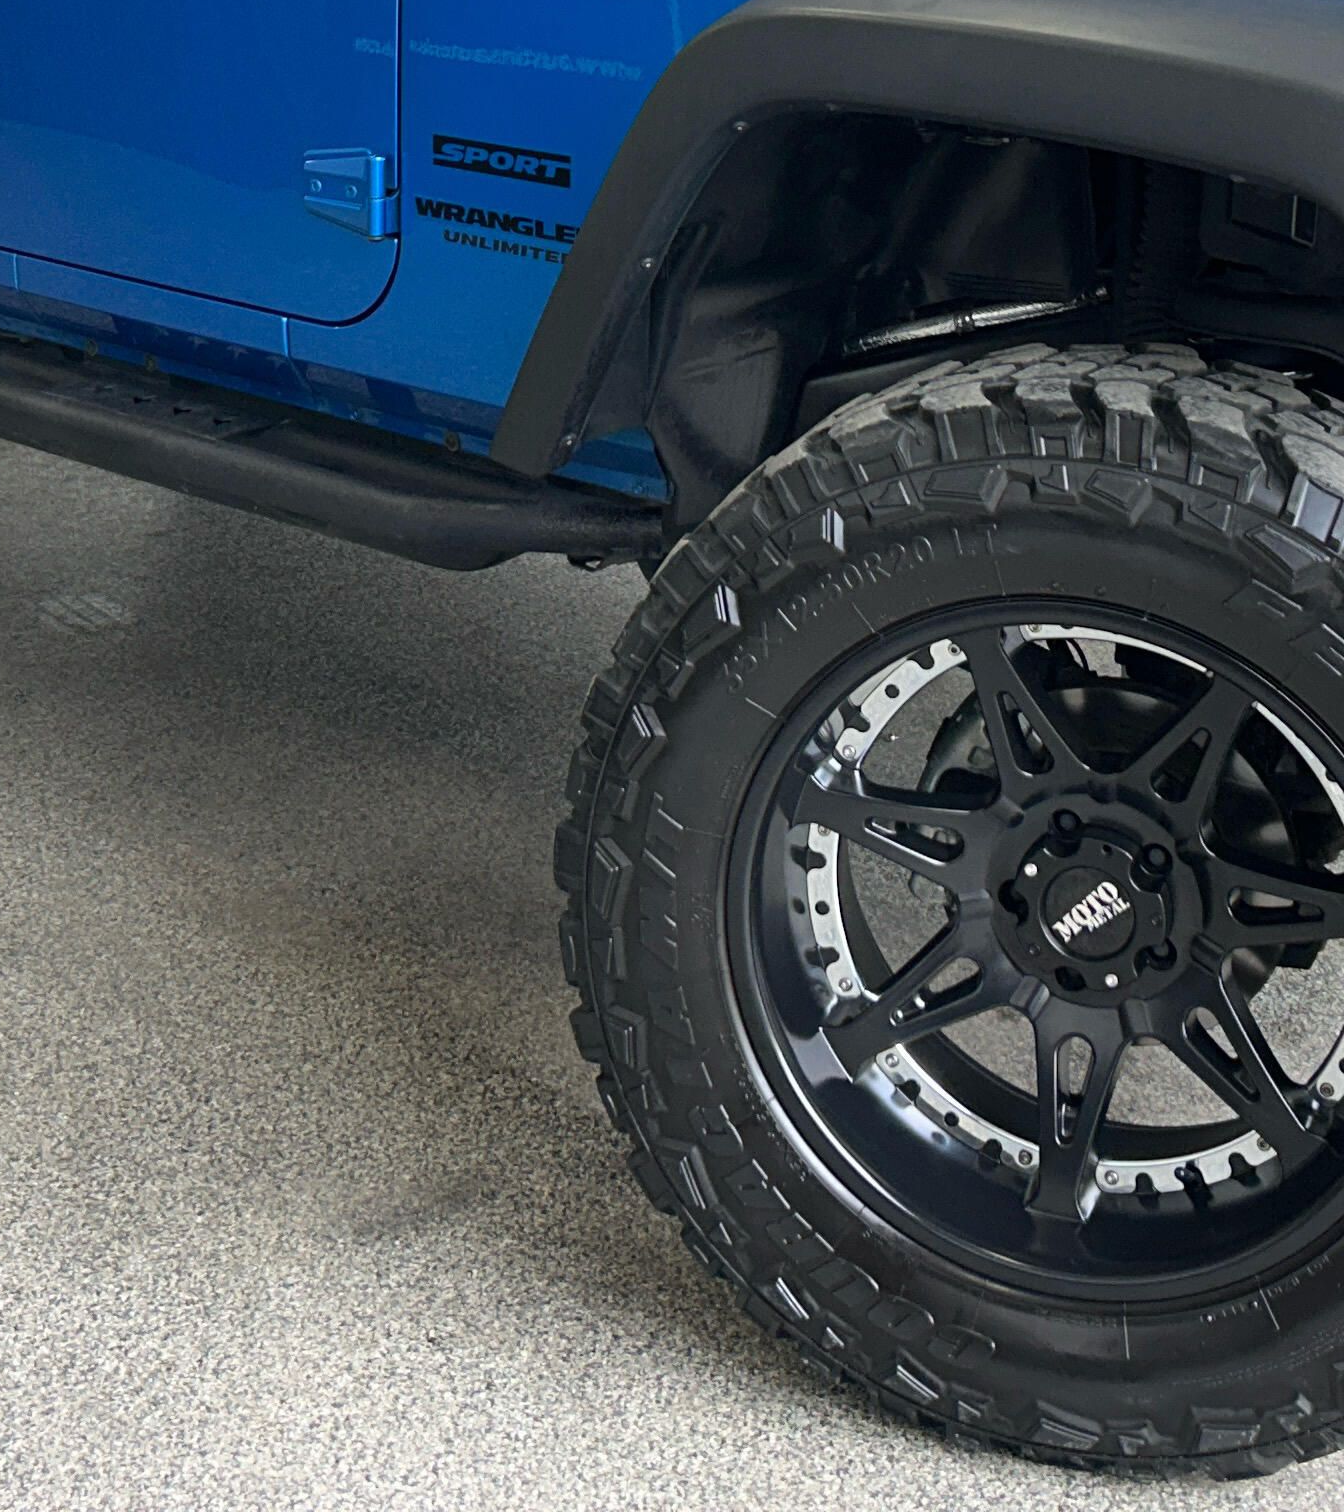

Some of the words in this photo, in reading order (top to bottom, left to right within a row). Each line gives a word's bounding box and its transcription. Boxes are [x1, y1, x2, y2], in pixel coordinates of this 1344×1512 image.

[436, 141, 570, 179] SPORT
[414, 196, 580, 244] WRANGLE
[1052, 881, 1118, 943] MOTO
